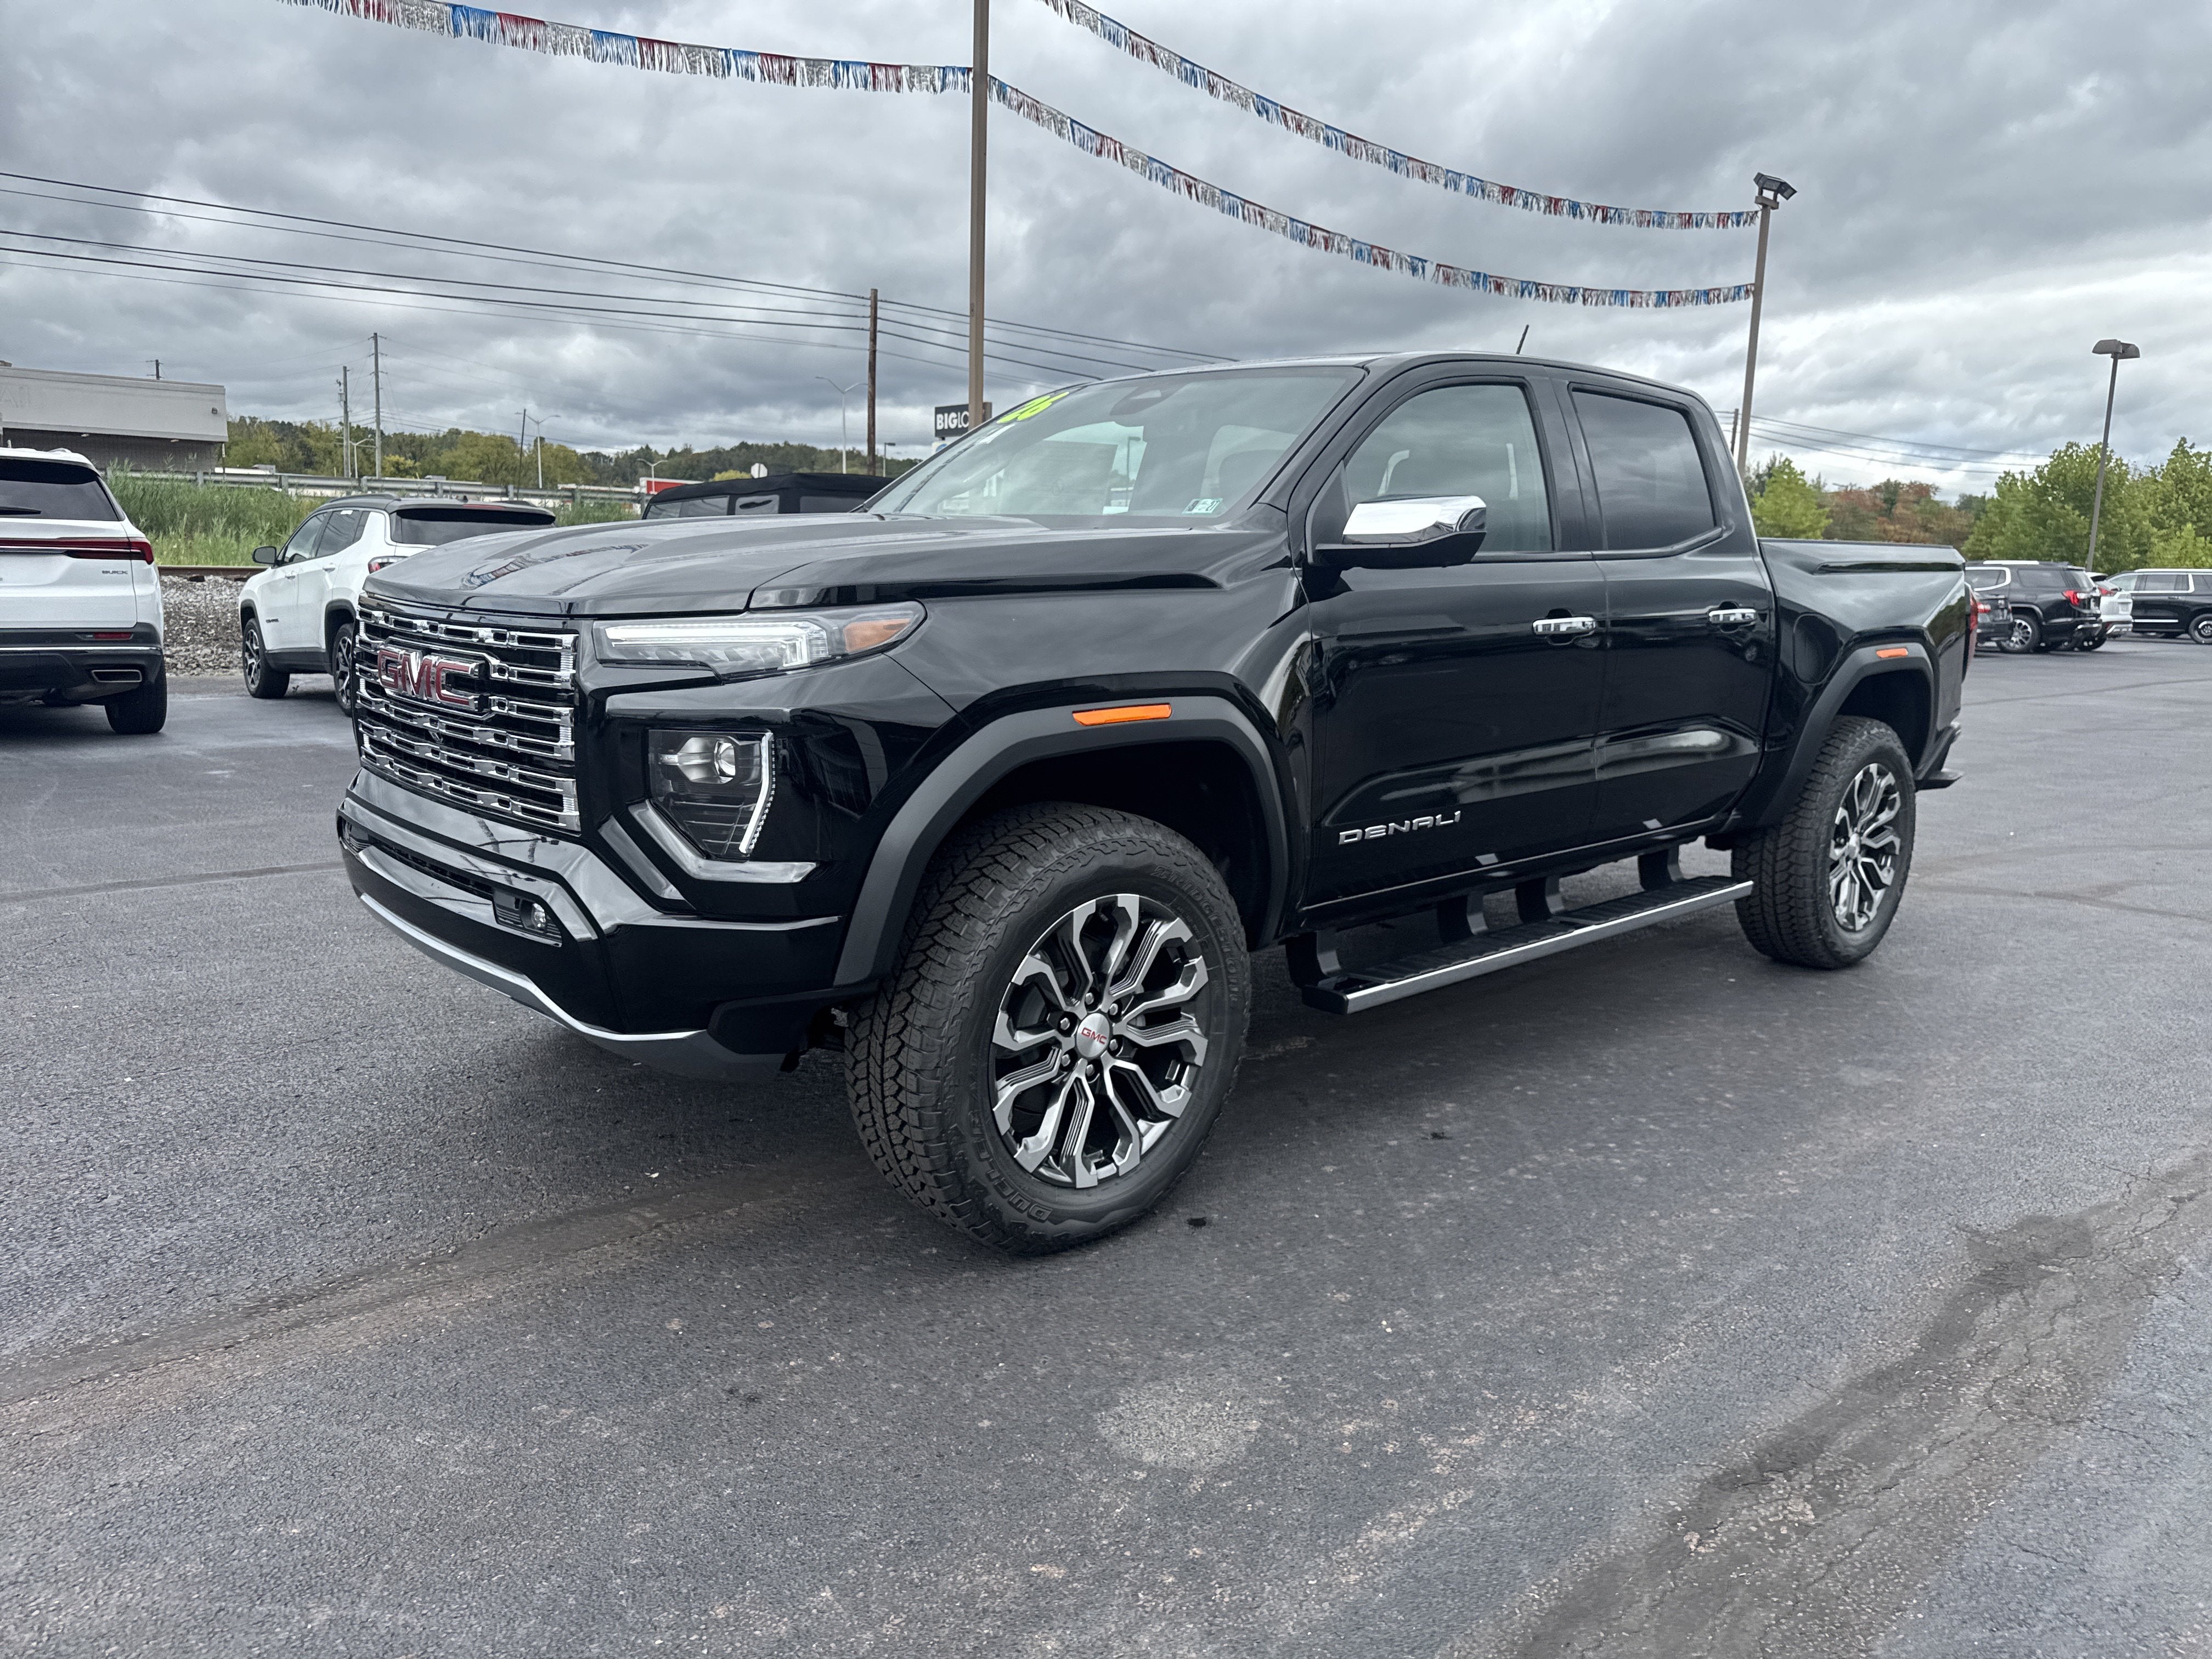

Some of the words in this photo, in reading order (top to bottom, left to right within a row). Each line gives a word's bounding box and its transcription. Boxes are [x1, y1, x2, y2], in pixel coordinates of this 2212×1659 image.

[377, 646, 479, 712] GMC
[1338, 810, 1461, 845] DENALI
[1081, 1027, 1107, 1045] GMC
